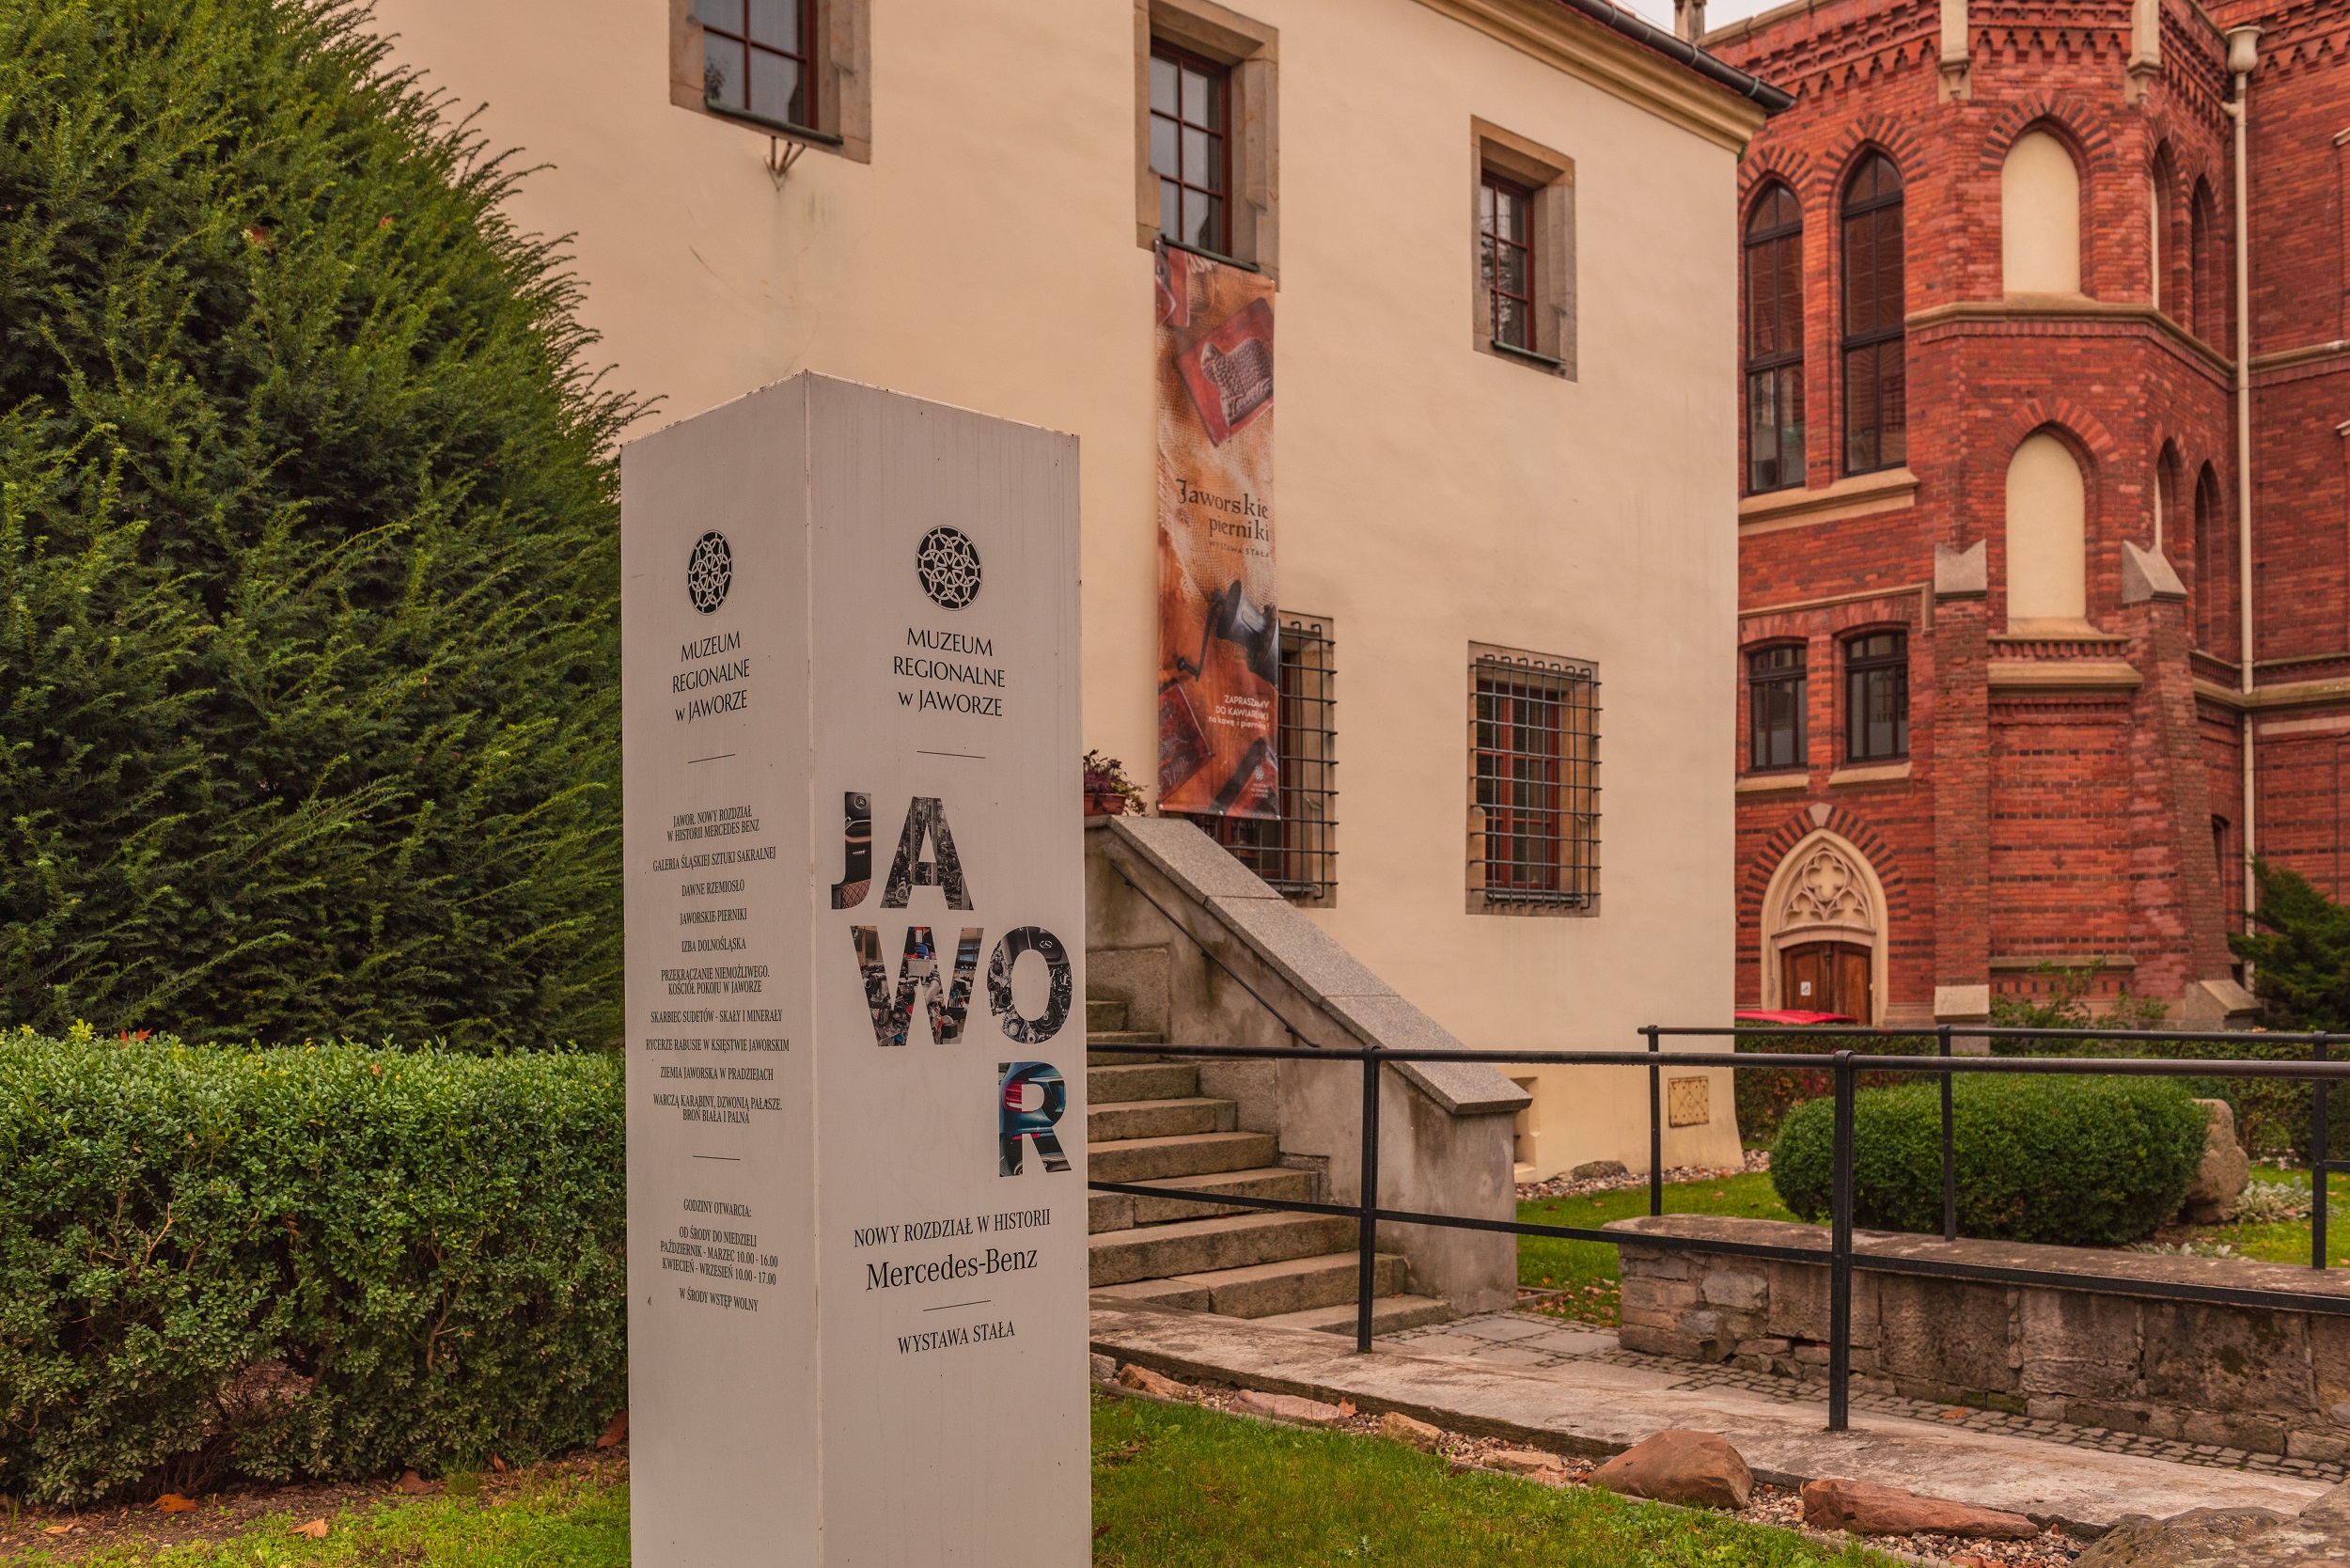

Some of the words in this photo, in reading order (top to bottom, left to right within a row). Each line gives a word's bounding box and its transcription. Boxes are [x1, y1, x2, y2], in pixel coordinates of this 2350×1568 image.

[1176, 478, 1268, 519] Jaworskie
[1209, 515, 1269, 541] pierniki
[1209, 541, 1243, 554] WYSTAWA
[681, 631, 741, 663] MUZEUM
[906, 627, 994, 657] MUZEUM
[672, 659, 750, 694] REGIONALNE
[893, 656, 1006, 688] REGIONALNE
[688, 690, 748, 725] JAWORZE
[918, 690, 1003, 717] JAWORZE
[1215, 705, 1226, 714] DO
[673, 814, 696, 828] JAWOR.
[697, 810, 717, 823] NOWY
[719, 806, 752, 821] ROZDZIAŁ
[667, 831, 674, 842] W
[675, 825, 703, 841] HISTORII
[704, 823, 740, 838] MERCEDES
[742, 819, 760, 833] BENZ
[653, 858, 680, 871] GALERIA
[682, 854, 711, 870] ŚLĄSKIEJ
[712, 852, 735, 865] SZTUKI
[737, 846, 776, 862] SAKRALNEJ
[831, 792, 974, 910] JA
[682, 883, 705, 896] DAWNE
[707, 879, 744, 894] RZEMIOSŁO
[680, 911, 715, 925] JAWORSKIE
[717, 908, 747, 921] PIERNIKI
[682, 940, 696, 952] IZBA
[697, 935, 746, 952] DOLNOŚLĄSKA
[661, 967, 713, 980] PRZEKRACZANIE
[714, 964, 769, 979] NIEMOŻLIWEGO.
[668, 980, 696, 995] KOŚCIÓŁ
[697, 981, 721, 995] POKOJU
[723, 981, 729, 993] W
[731, 980, 761, 994] JAWORZE
[850, 926, 1073, 1047] WO
[651, 1011, 682, 1023] SKARBIEC
[683, 1008, 714, 1023] SUDETÓW
[719, 1011, 741, 1022] SKAŁY
[743, 1011, 745, 1021] I
[747, 1010, 782, 1022] MINERAŁY
[646, 1039, 672, 1050] RYCERZE
[674, 1039, 701, 1050] RABUSIE
[703, 1039, 710, 1051] W
[712, 1039, 747, 1053] KSIĘSTWIE
[749, 1039, 790, 1053] JAWORSKIM
[660, 1067, 682, 1078] ZIEMIA
[684, 1067, 717, 1079] JAWORSKA
[719, 1068, 727, 1079] W
[728, 1069, 774, 1081] PRADZIEJACH
[653, 1094, 679, 1108] WARCZĄ
[681, 1095, 716, 1108] KARABINY,
[717, 1096, 749, 1111] DZWONIĄ
[751, 1098, 782, 1111] PAŁASZE.
[682, 1107, 700, 1121] BROŃ
[702, 1110, 722, 1122] BIAŁA
[724, 1111, 727, 1122] I
[728, 1111, 749, 1123] PALNA
[998, 1061, 1072, 1177] R
[683, 1199, 713, 1214] GODZINY
[713, 1202, 752, 1217] OTWARCIA:
[679, 1226, 688, 1238] OD
[690, 1225, 711, 1241] ŚRODY
[713, 1231, 722, 1243] DO
[724, 1231, 757, 1247] NIEDZIELI
[854, 1225, 900, 1247] NOWY
[903, 1217, 974, 1242] ROZDZIAŁ
[977, 1215, 990, 1232] W
[994, 1209, 1051, 1231] HISTORII
[660, 1239, 702, 1258] PAŹDZIERNIK
[707, 1247, 735, 1262] MARZEC
[737, 1250, 754, 1264] 10.00
[760, 1254, 778, 1267] 16.00
[662, 1258, 695, 1273] KWIECIEŃ
[699, 1262, 734, 1278] WRZESIEŃ
[735, 1268, 752, 1281] 10.00
[759, 1272, 776, 1285] 17.00
[866, 1247, 1038, 1291] Mercedes-Benz
[679, 1287, 686, 1299] W
[687, 1286, 709, 1304] ŚRODY
[710, 1293, 732, 1309] WSTĘP
[734, 1296, 759, 1311] WOLNY
[898, 1326, 969, 1355] WYSTAWA
[973, 1320, 1015, 1342] STAŁA
